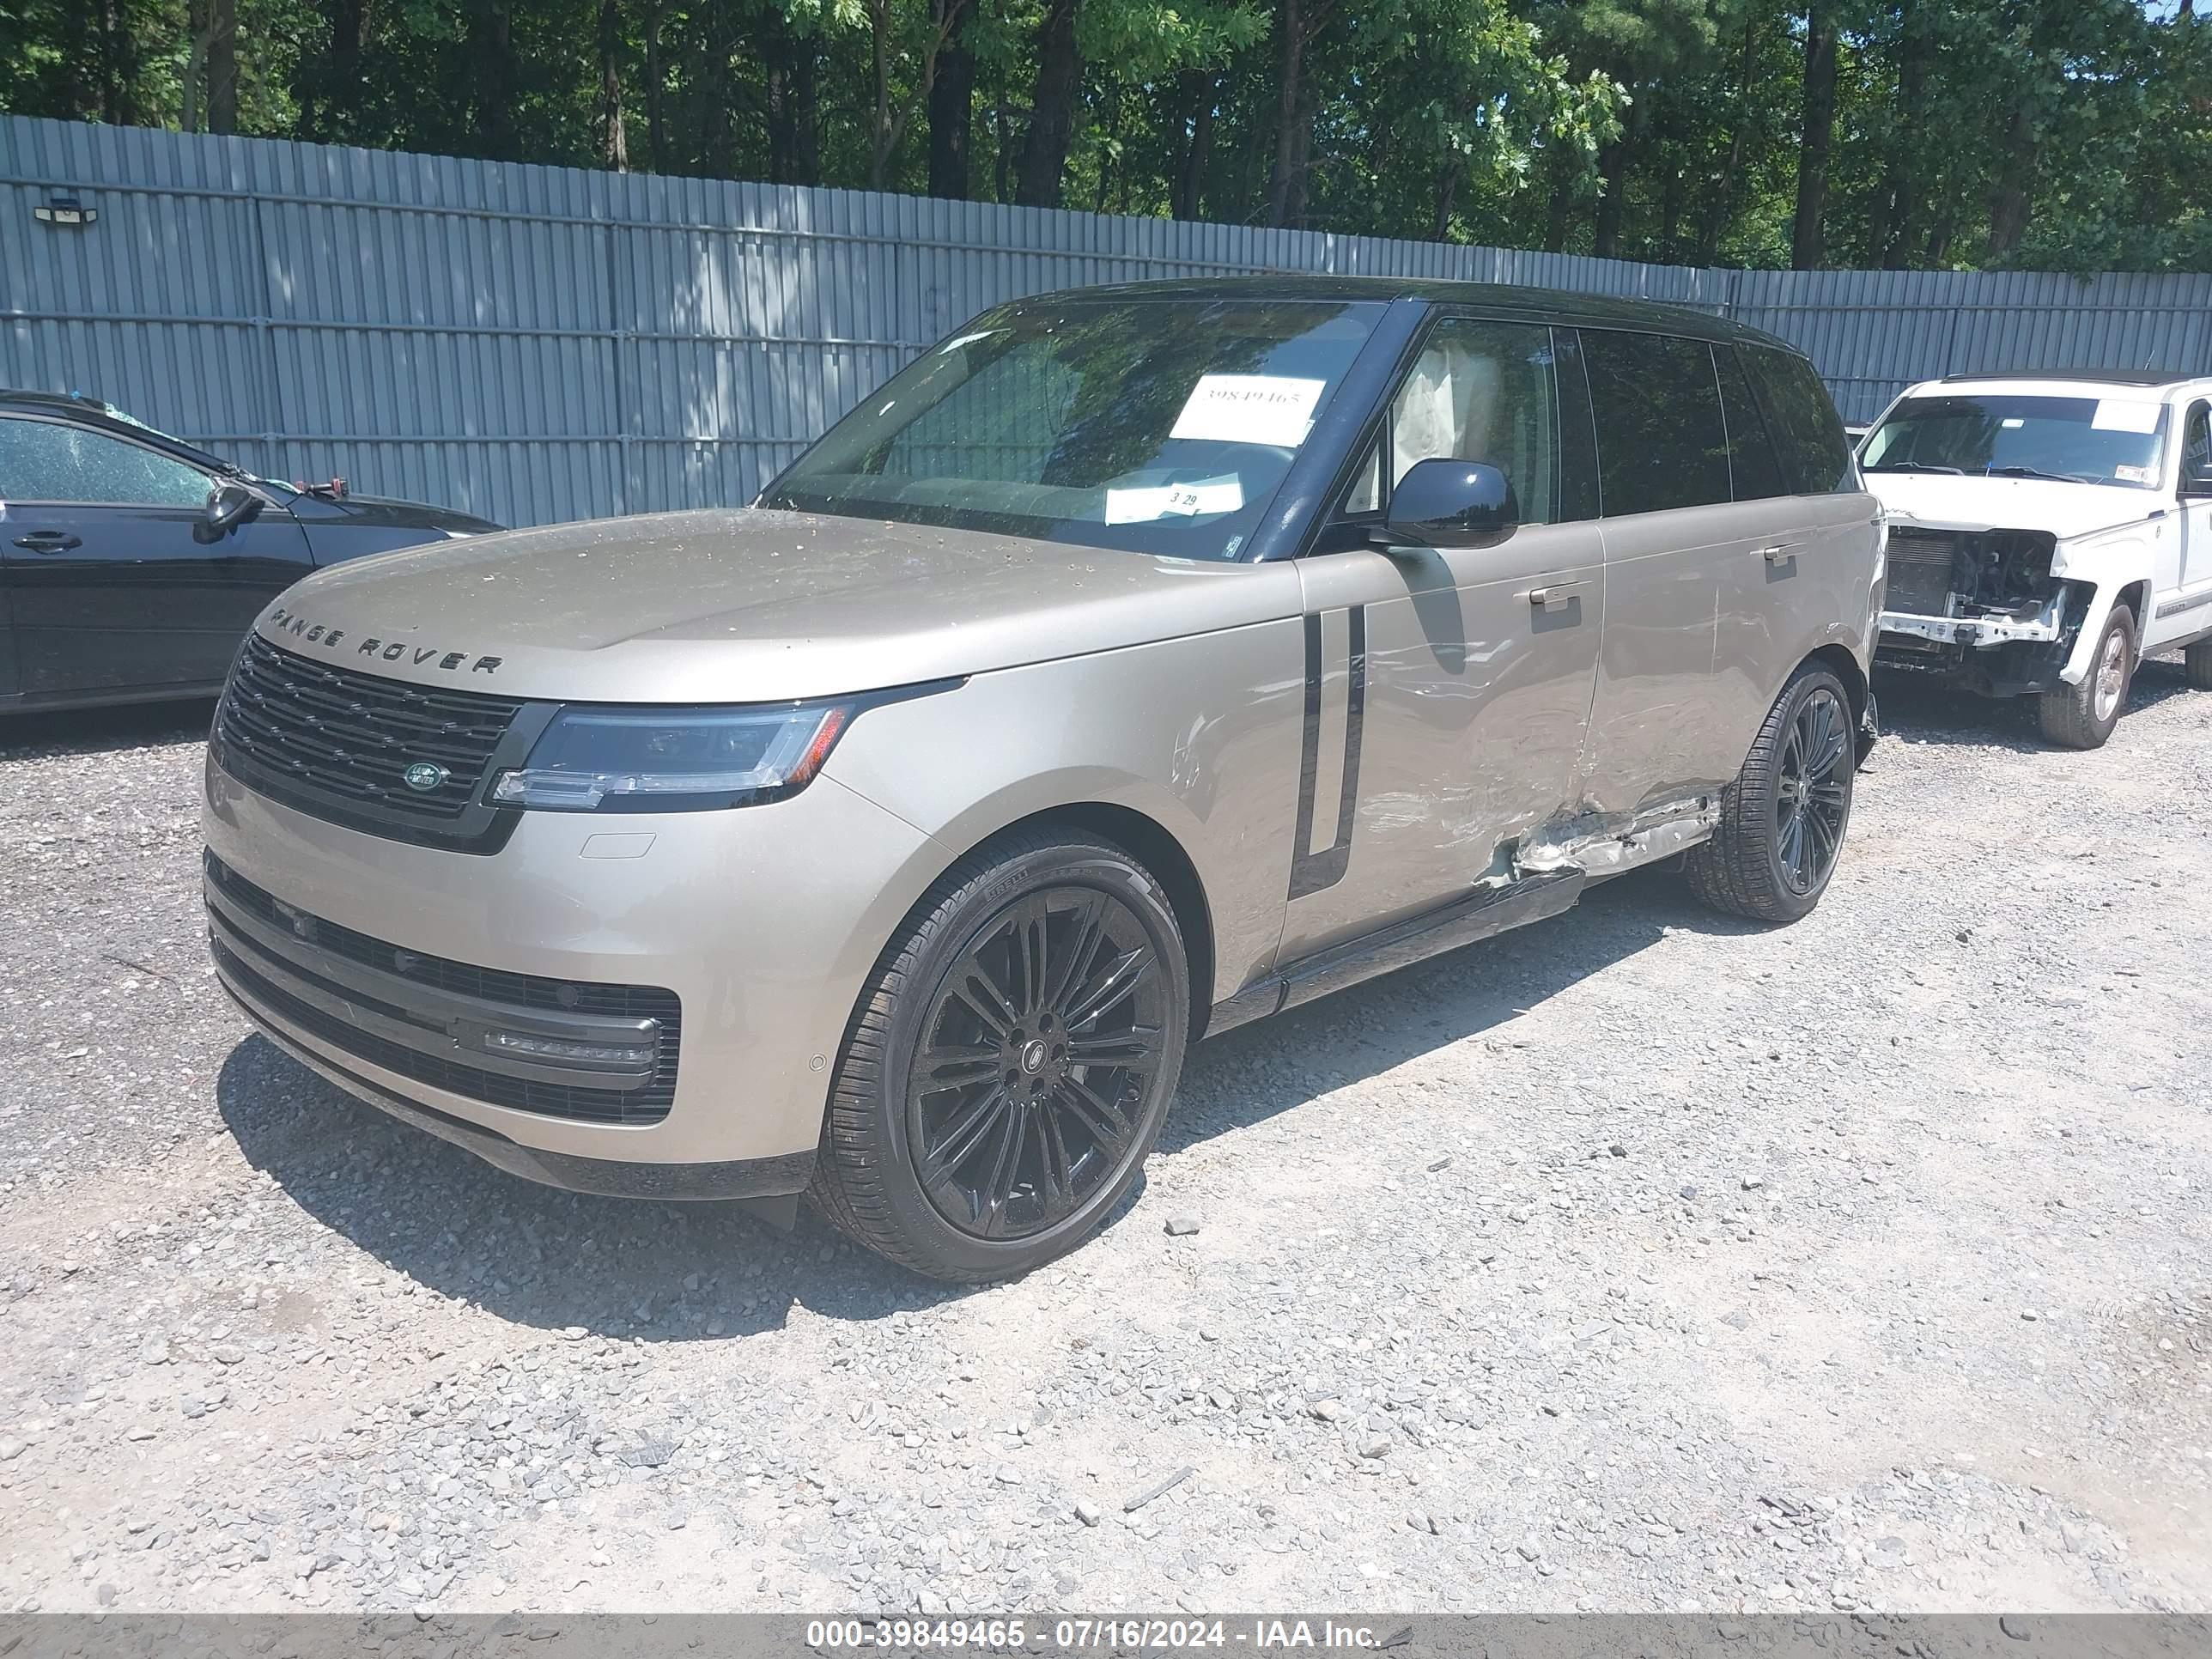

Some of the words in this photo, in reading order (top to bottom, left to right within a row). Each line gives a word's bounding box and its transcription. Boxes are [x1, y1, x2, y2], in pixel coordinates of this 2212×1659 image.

[1170, 492, 1180, 502] 3
[1182, 495, 1198, 506] 29
[268, 608, 345, 647] RANGE
[357, 638, 504, 674] ROVER
[412, 766, 430, 775] LAND
[411, 775, 434, 785] ROVER
